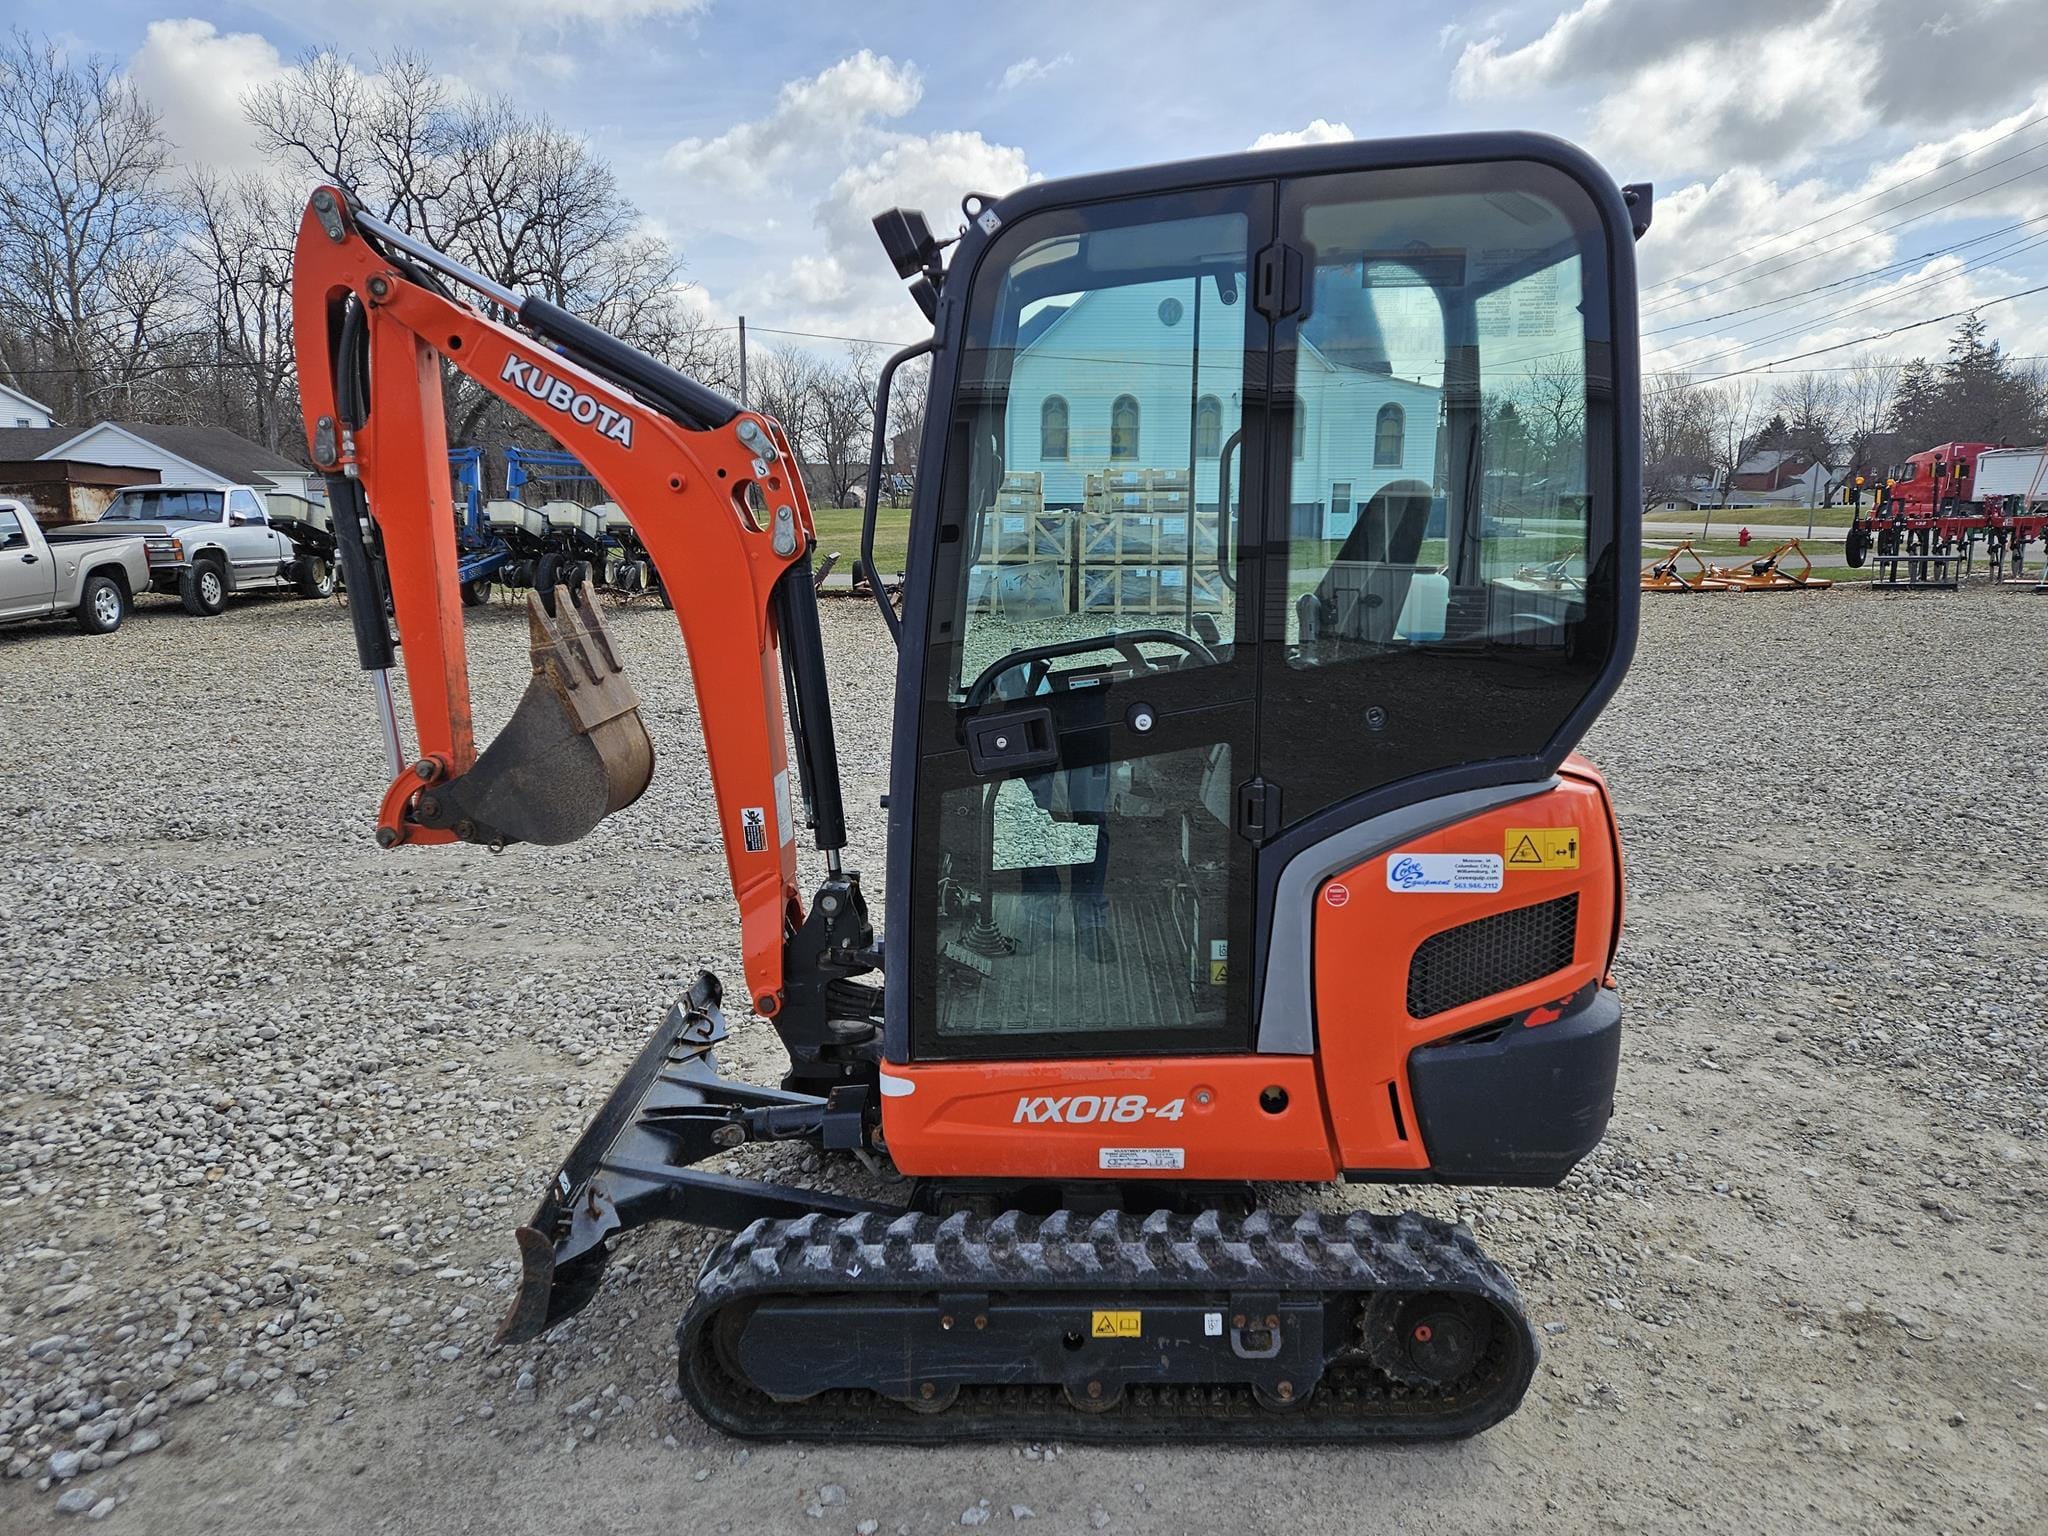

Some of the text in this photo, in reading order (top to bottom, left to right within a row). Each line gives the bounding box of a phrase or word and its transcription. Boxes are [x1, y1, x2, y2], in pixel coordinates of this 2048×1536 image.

[501, 353, 633, 449] KUBOTA
[1391, 857, 1424, 881] Cove
[1402, 876, 1451, 889] Equipment
[1012, 1095, 1185, 1123] KX018-4
